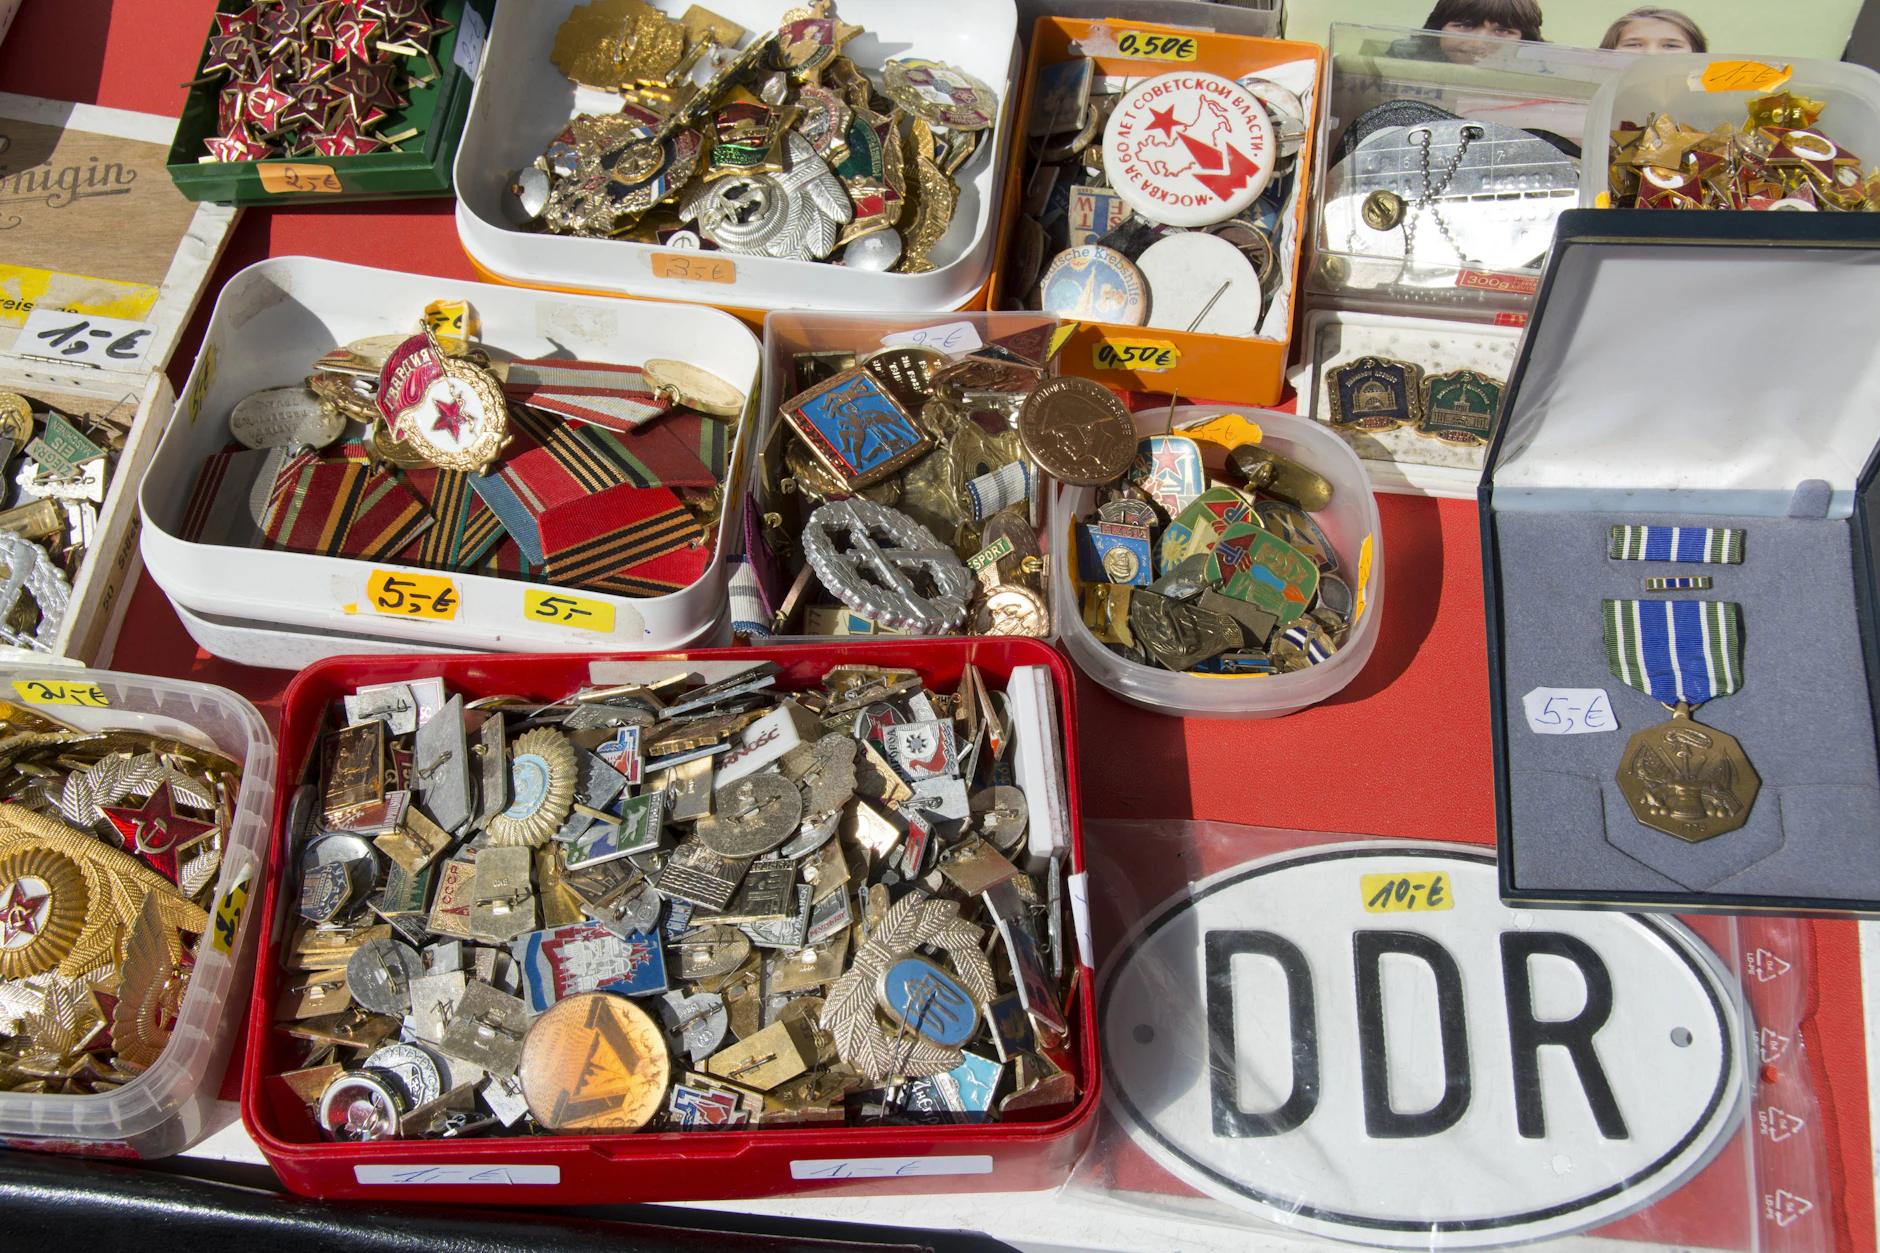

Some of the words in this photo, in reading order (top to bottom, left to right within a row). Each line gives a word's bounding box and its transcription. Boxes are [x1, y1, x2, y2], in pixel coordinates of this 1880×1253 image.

[1119, 34, 1194, 58] 0,50€
[1133, 77, 1232, 110] СОВЕТСКОЙ
[1119, 112, 1138, 141] ЛЕТ
[1232, 96, 1264, 152] ВЛАСТИ
[1140, 180, 1211, 207] МОСКВА
[1467, 275, 1510, 290] 300g
[37, 321, 152, 359] 1,-€
[1097, 342, 1174, 367] 0,50€
[50, 419, 95, 458] MASCHINEN
[51, 436, 77, 461] EIS
[32, 440, 72, 477] ZIEGRA
[971, 540, 1008, 571] SPORT
[378, 576, 457, 614] 5,-€
[535, 596, 593, 620] 5,-
[1536, 695, 1607, 732] 5,-€
[441, 864, 459, 906] СССР
[1367, 874, 1447, 911] 10,-€
[1746, 952, 1755, 976] LD-PE
[1204, 928, 1630, 1142] DDR
[1751, 1030, 1761, 1055] LD-PE
[1759, 1110, 1769, 1136] LD-PE
[1764, 1194, 1775, 1220] LD-PE
